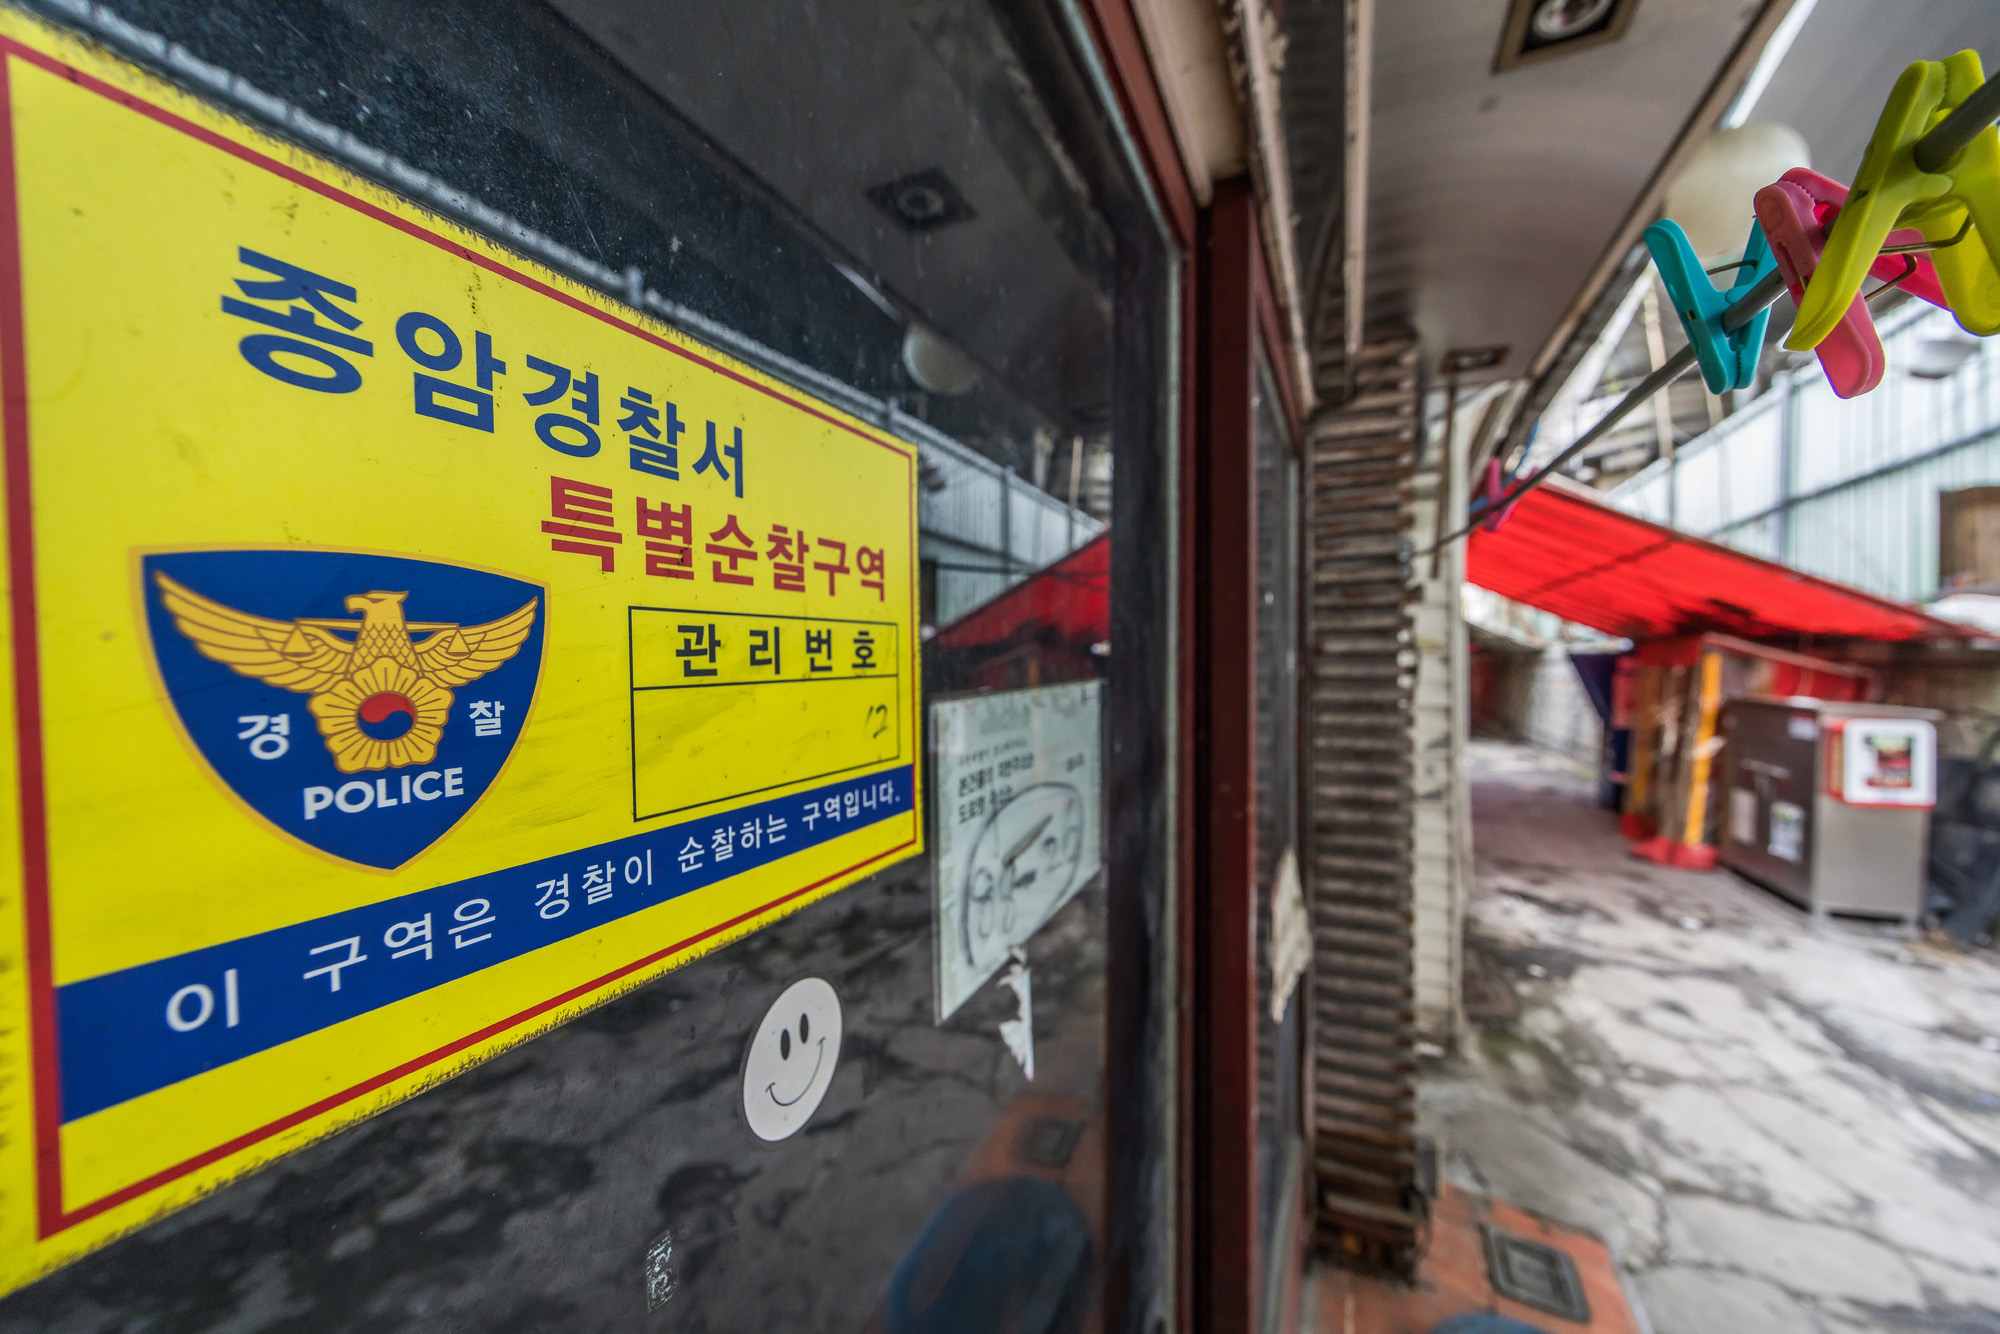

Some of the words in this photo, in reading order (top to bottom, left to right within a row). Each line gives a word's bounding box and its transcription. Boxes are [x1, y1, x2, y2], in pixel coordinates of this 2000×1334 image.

[221, 246, 743, 498] 종암경찰서
[541, 475, 885, 602] 특별순찰구역
[866, 703, 888, 739] 12
[303, 766, 464, 820] POLICE
[165, 968, 239, 1032] 이
[303, 898, 497, 993] 구역은
[534, 847, 655, 920] 경찰이
[677, 810, 788, 873] 순찰하는
[801, 778, 902, 833] 구역입니다.
